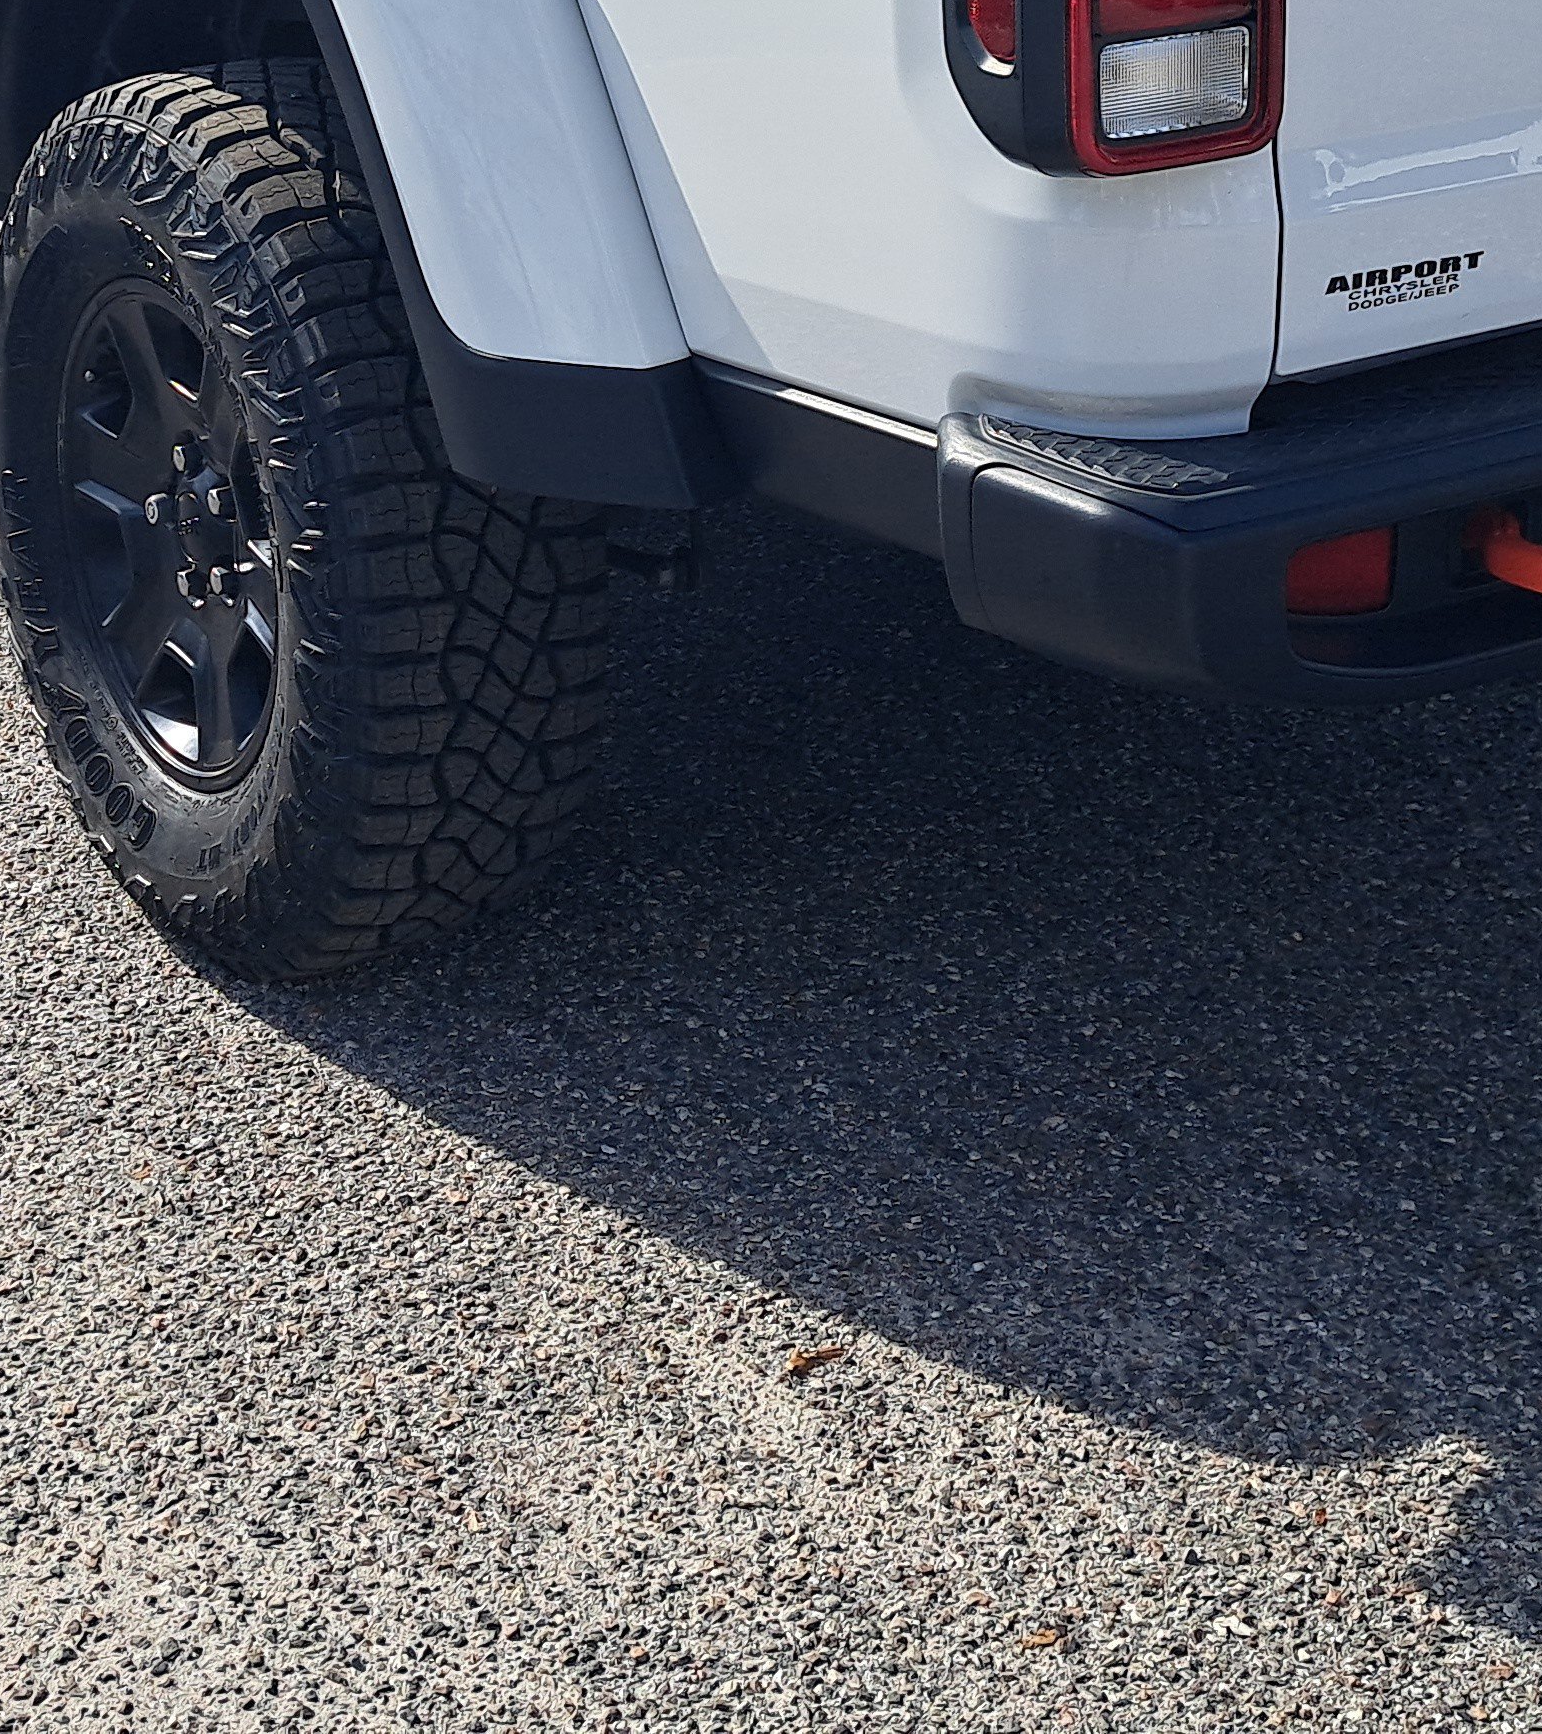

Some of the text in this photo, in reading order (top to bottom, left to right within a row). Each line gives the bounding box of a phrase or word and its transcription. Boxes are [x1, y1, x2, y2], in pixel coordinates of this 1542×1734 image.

[1324, 250, 1485, 296] AIRPORT
[1348, 273, 1460, 301] CHRYSLER
[1348, 283, 1460, 312] DODGE/JEEP
